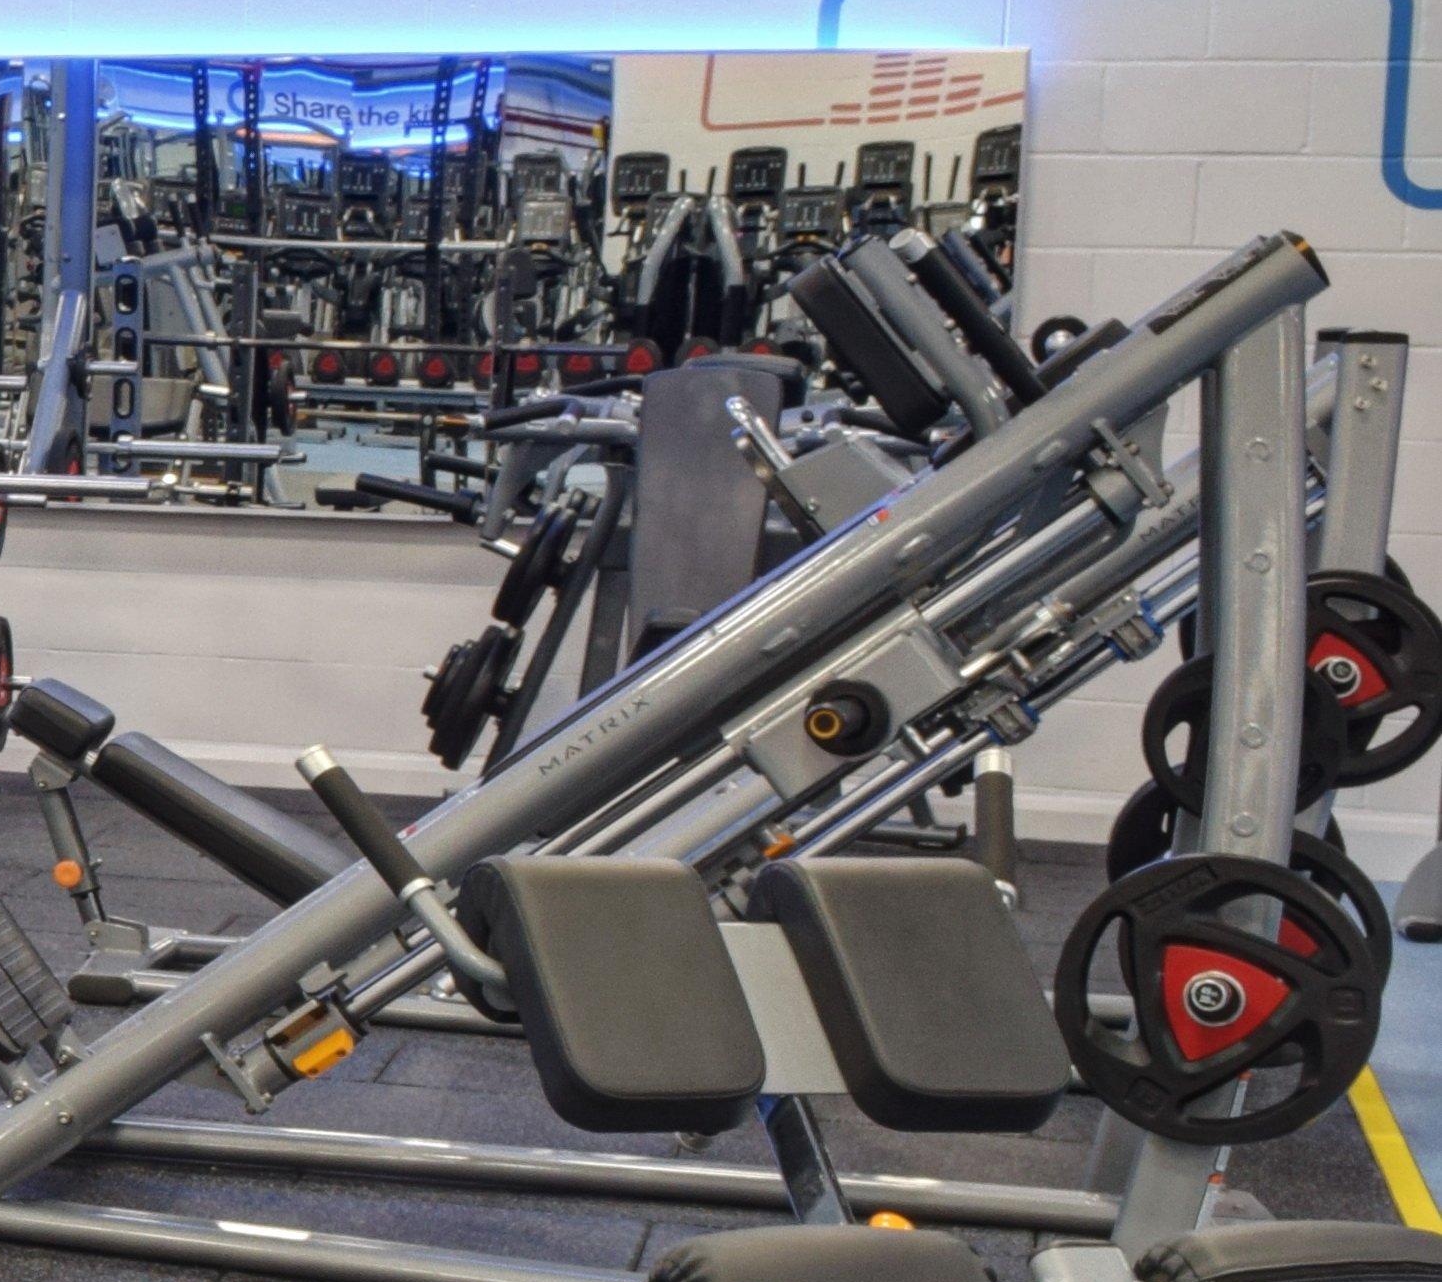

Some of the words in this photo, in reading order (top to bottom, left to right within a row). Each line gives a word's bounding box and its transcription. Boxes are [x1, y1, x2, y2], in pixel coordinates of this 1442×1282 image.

[274, 91, 352, 120] Share
[357, 105, 400, 127] the
[409, 103, 436, 123] ki
[537, 697, 650, 777] MATRIX
